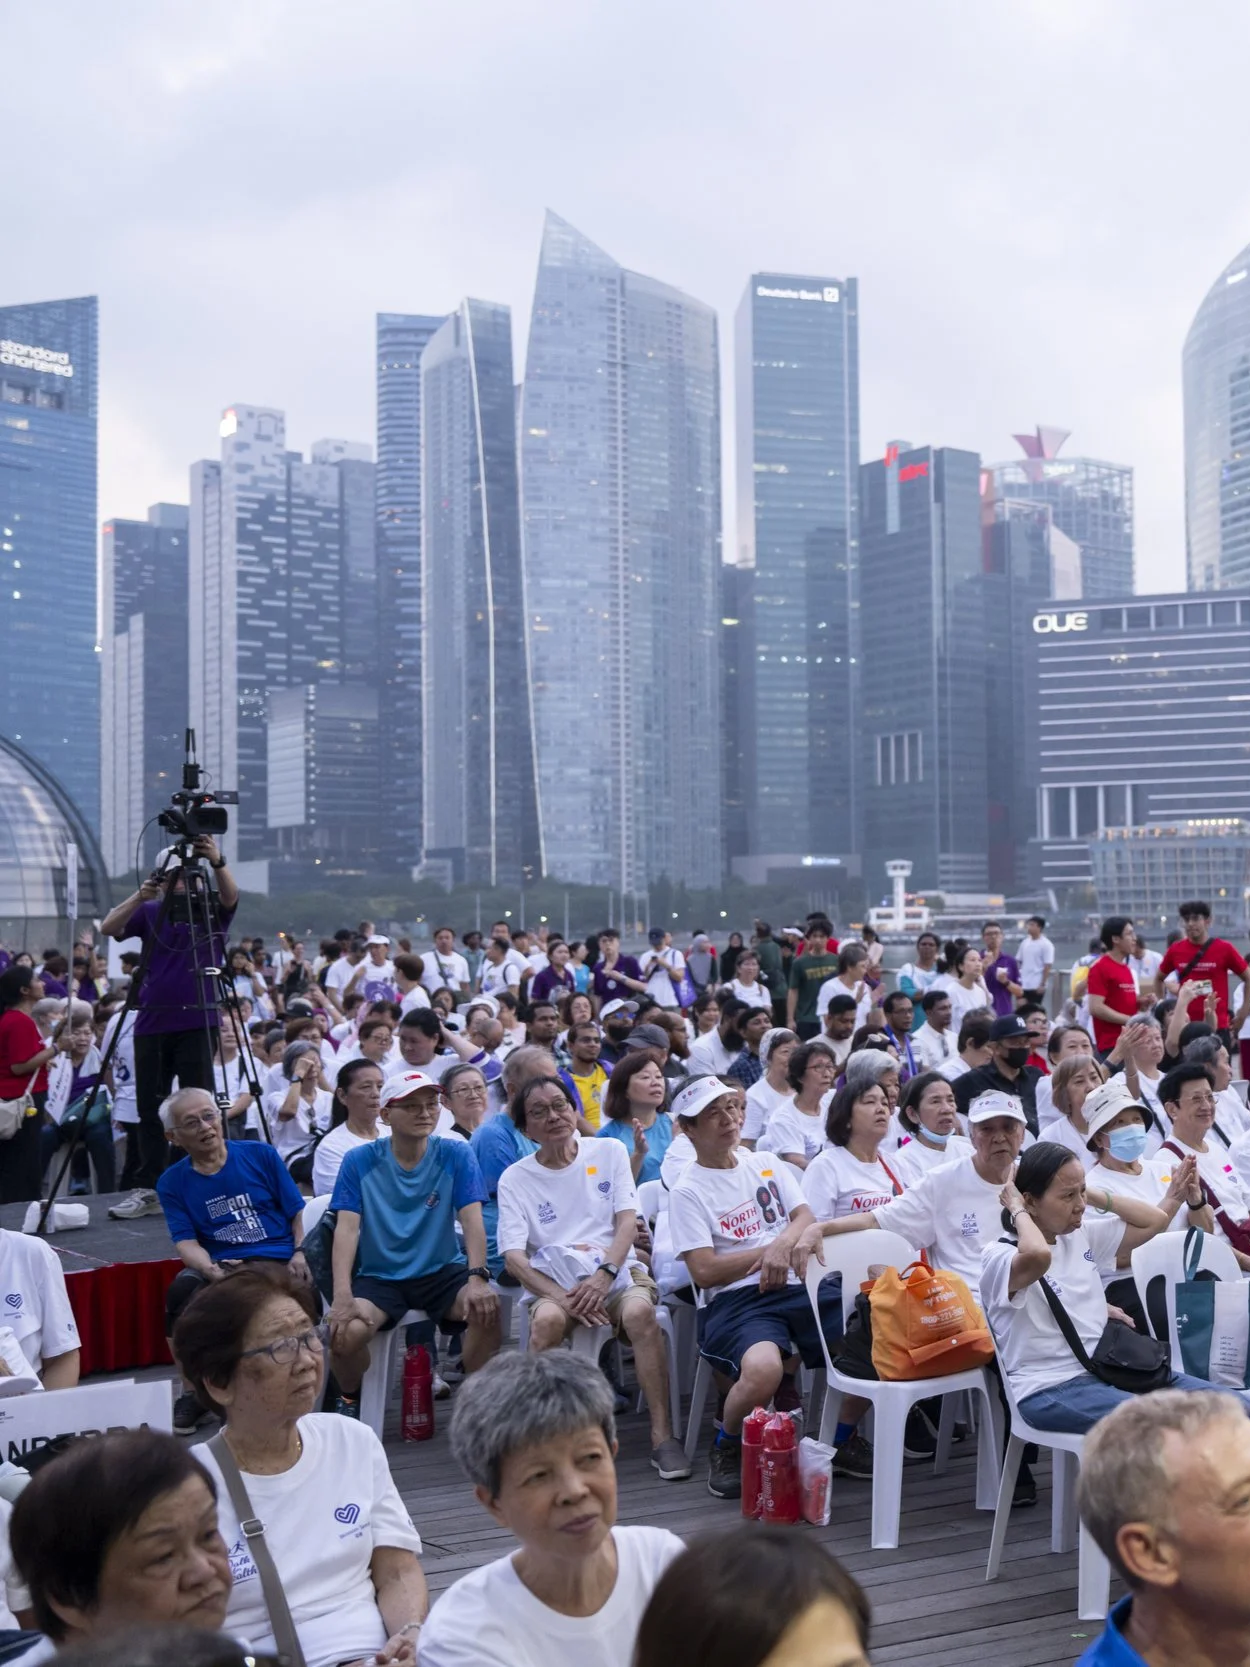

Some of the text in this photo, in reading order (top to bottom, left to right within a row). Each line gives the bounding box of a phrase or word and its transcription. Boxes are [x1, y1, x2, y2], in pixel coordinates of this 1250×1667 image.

[0, 339, 69, 364] standard
[0, 353, 73, 377] chartered
[1032, 611, 1089, 634] OUE
[851, 1196, 892, 1211] NORTH
[720, 1207, 757, 1234] NORTH
[733, 1219, 761, 1239] WEST
[232, 1565, 258, 1581] ealth
